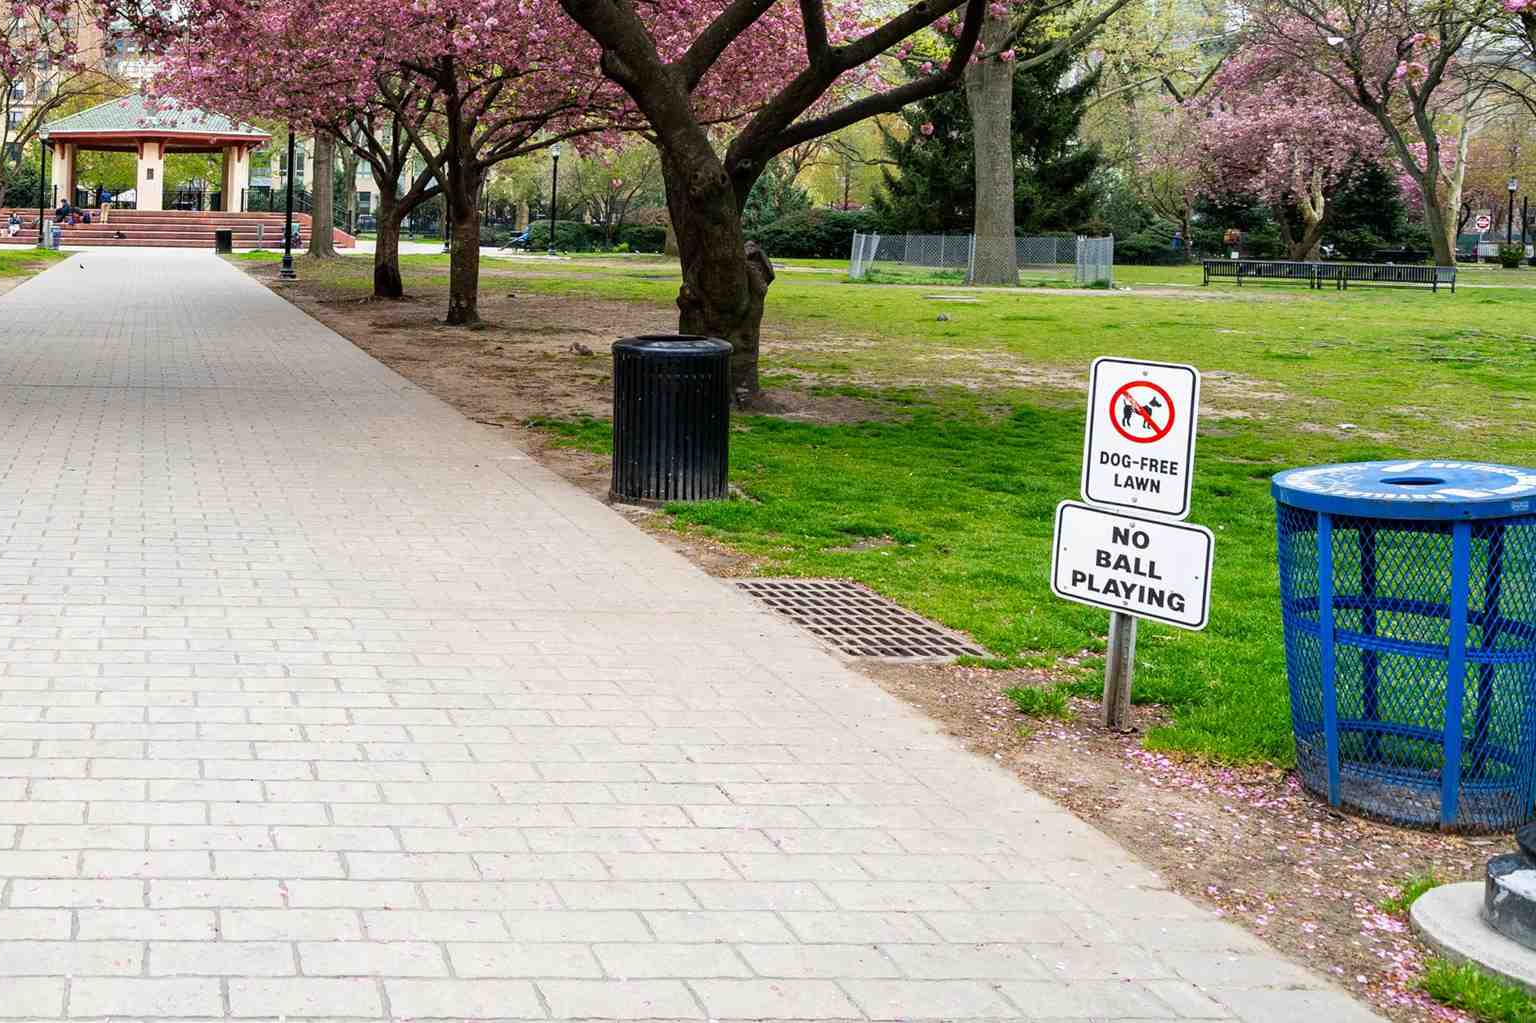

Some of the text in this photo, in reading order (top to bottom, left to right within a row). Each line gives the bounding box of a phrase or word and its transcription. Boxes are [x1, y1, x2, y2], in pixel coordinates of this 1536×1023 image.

[1099, 451, 1179, 476] DOG-FREE
[1114, 473, 1161, 494] LAWN
[1111, 526, 1150, 549] NO
[1095, 549, 1162, 580] BALL
[1071, 569, 1185, 613] PLAYING
